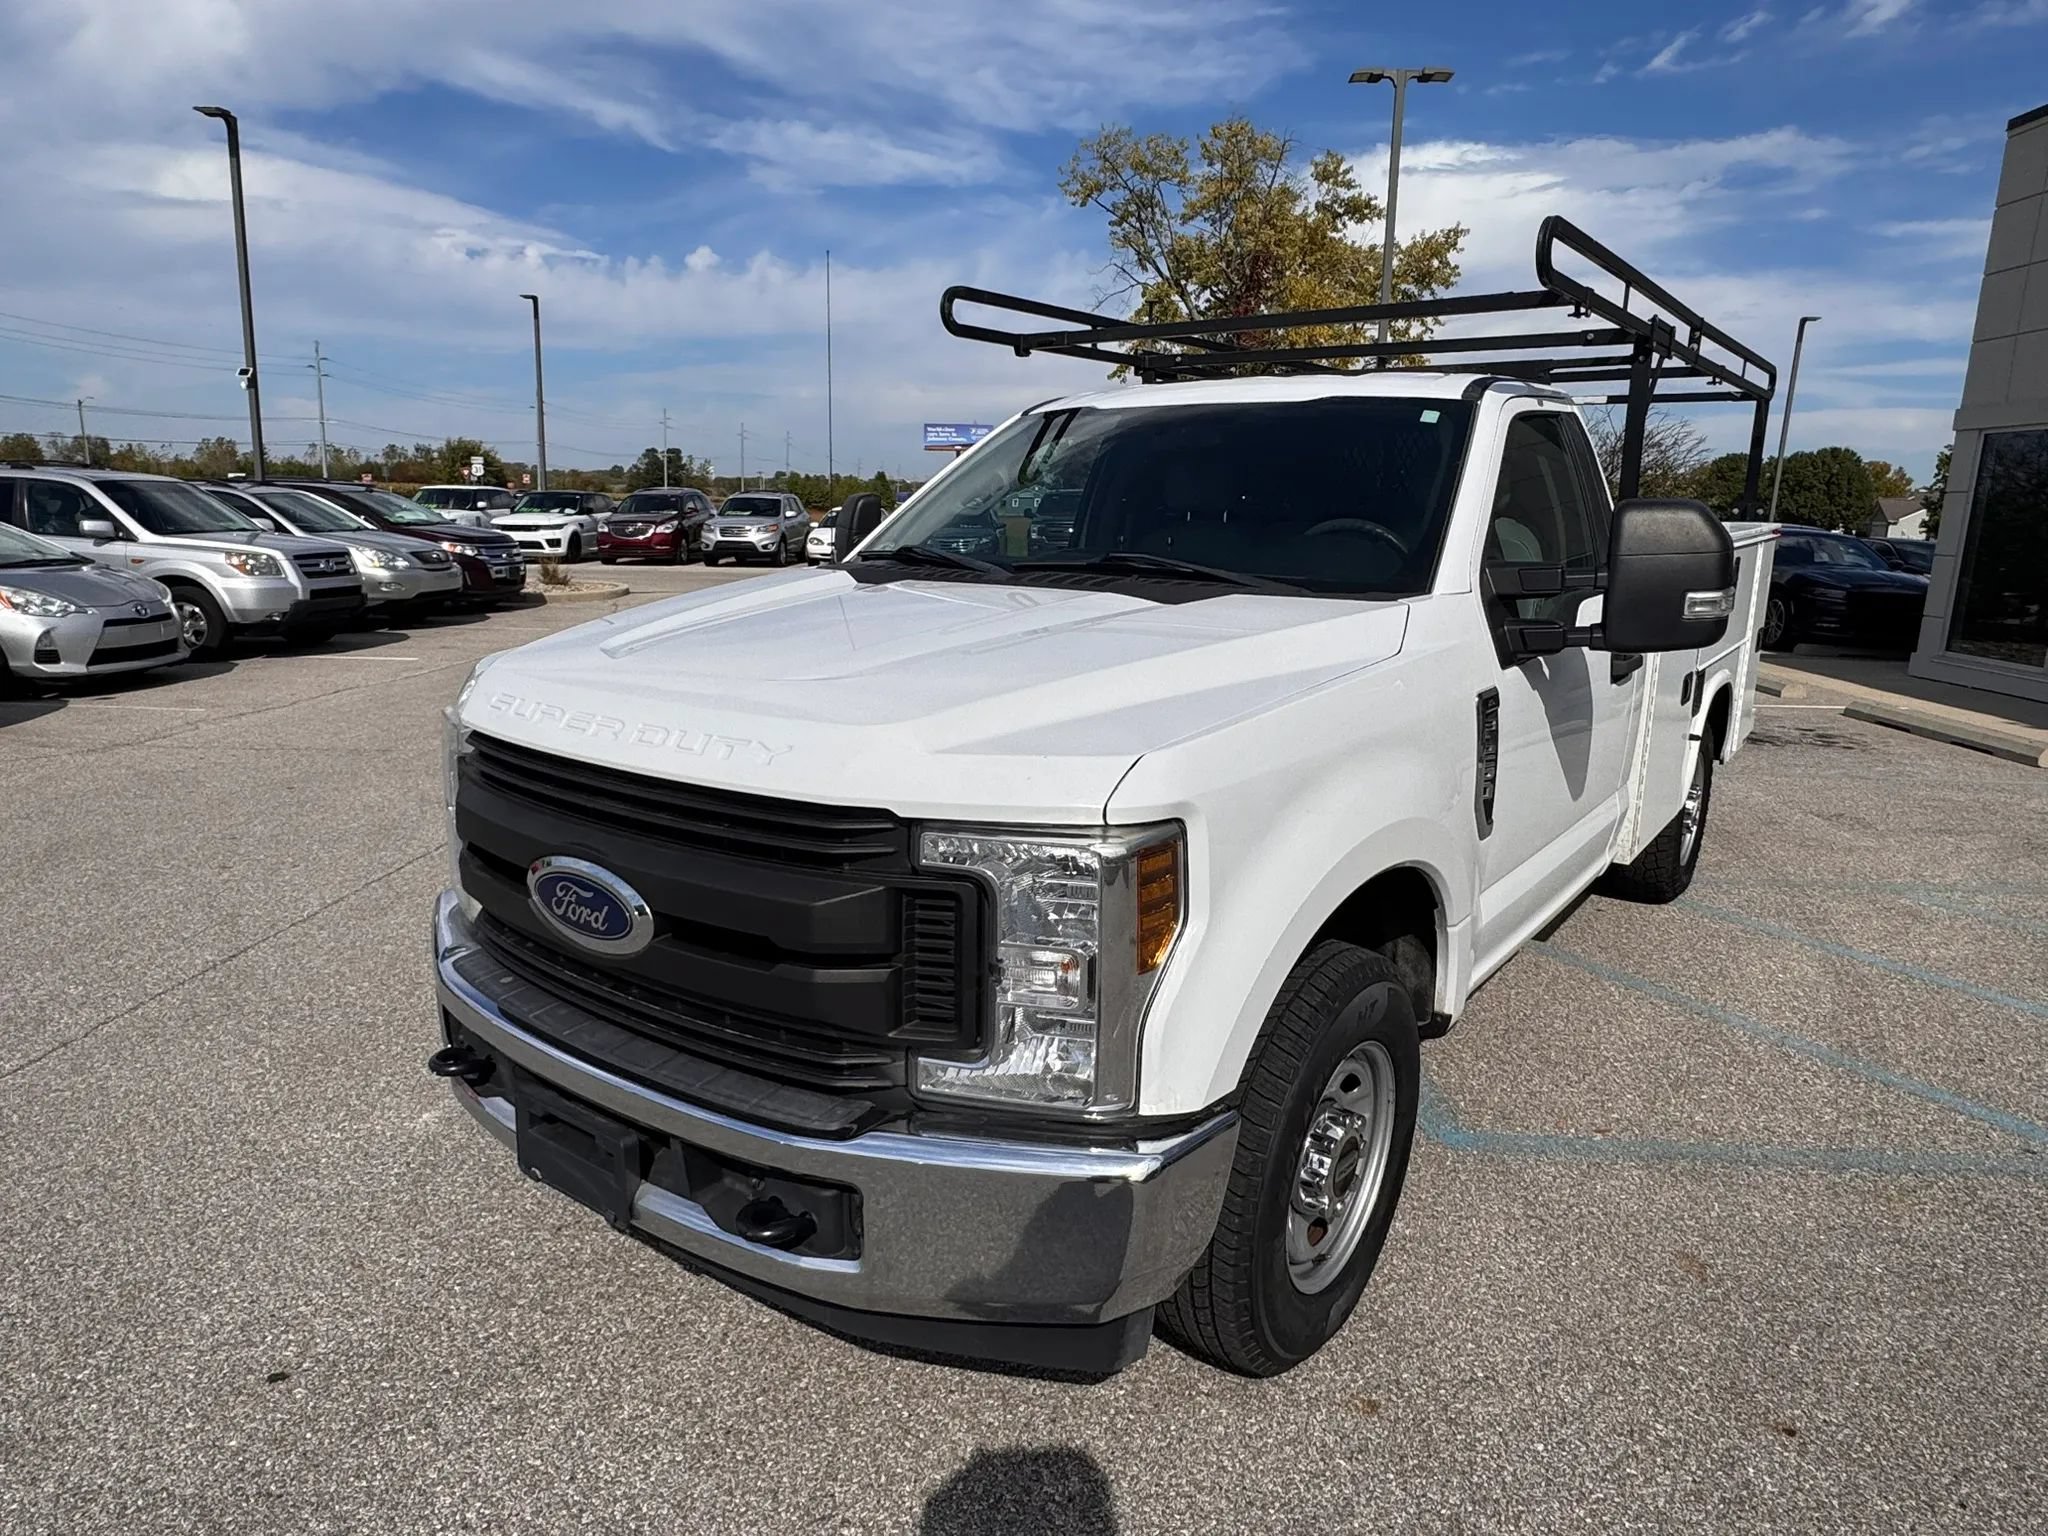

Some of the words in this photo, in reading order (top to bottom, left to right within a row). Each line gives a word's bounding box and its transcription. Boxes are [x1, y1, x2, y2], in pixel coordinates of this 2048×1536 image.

[474, 465, 482, 474] 31
[488, 692, 627, 741] SUPER
[629, 722, 794, 766] DUTY
[551, 881, 609, 931] Ford
